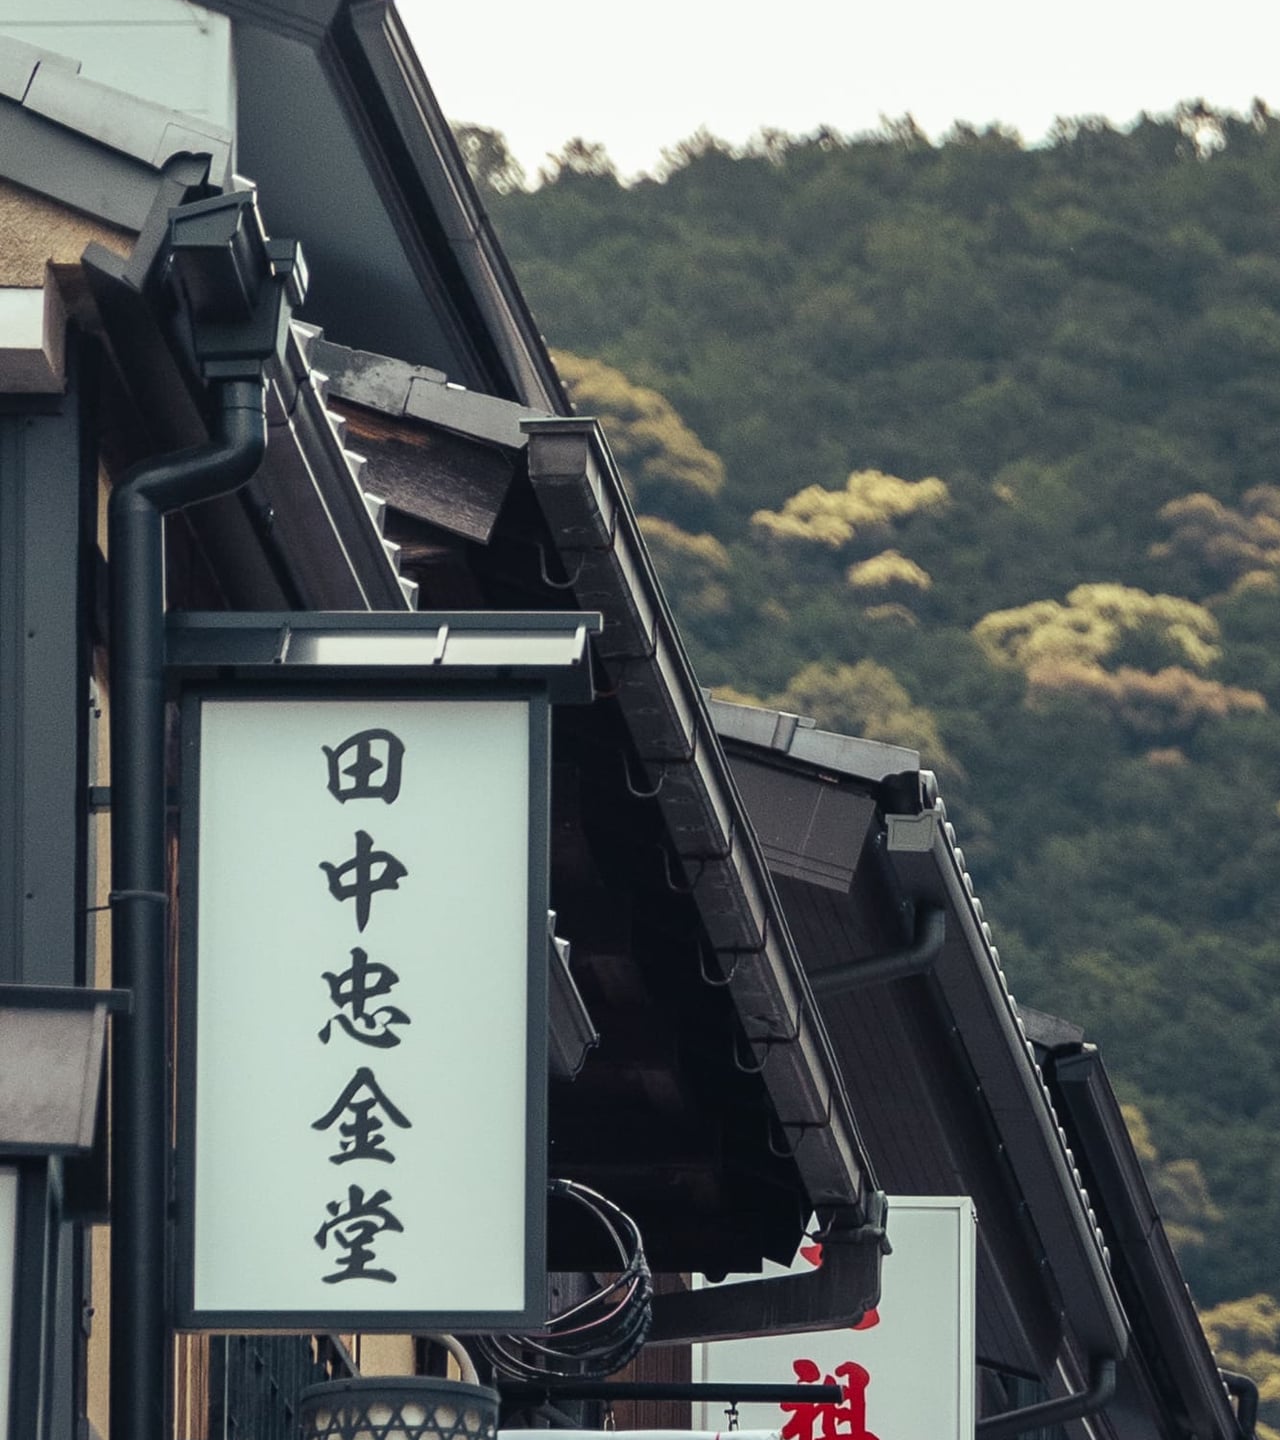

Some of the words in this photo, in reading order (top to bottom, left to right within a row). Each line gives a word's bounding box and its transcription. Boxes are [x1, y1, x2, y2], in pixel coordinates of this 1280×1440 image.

[312, 728, 412, 1284] 田中忠金堂
